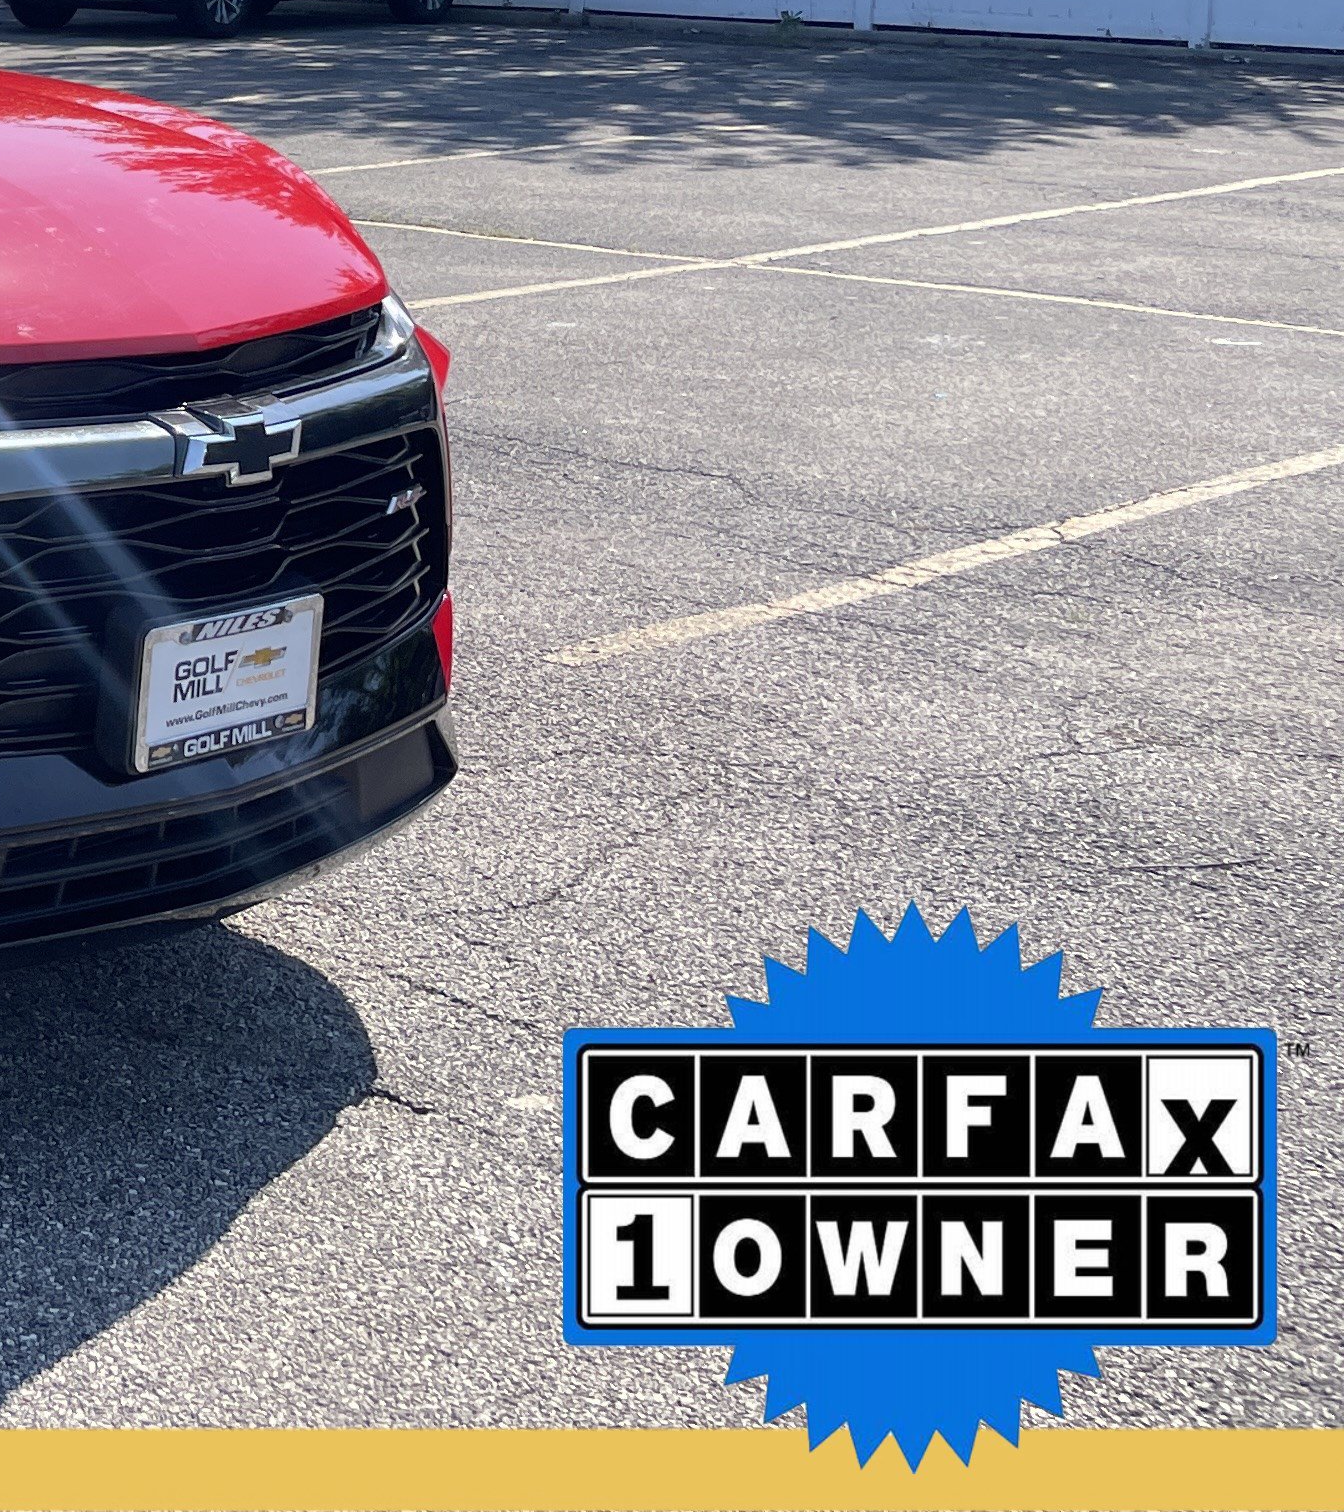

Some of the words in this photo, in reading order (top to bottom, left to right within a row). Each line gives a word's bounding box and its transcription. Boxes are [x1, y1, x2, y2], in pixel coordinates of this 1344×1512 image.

[195, 608, 282, 641] NILES
[174, 649, 239, 682] GOLF
[172, 674, 224, 704] MILL
[165, 692, 288, 728] www.GolfMillChevy.com
[183, 731, 230, 758] GOLF
[230, 720, 273, 746] MILL
